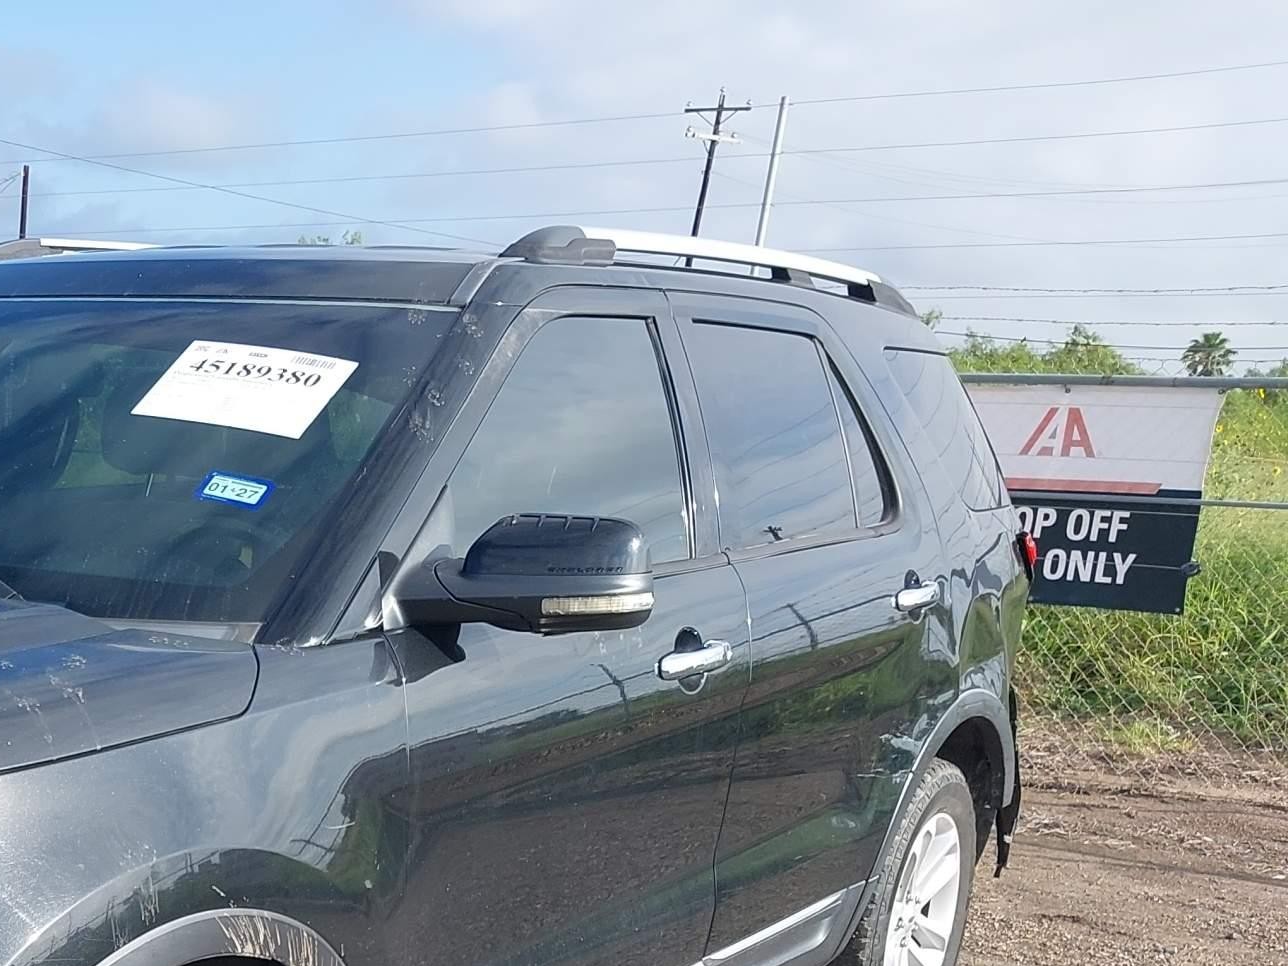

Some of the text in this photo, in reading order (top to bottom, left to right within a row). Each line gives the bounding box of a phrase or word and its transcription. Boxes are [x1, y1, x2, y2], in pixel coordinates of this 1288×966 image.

[188, 358, 322, 388] 45189380
[1066, 507, 1132, 543] OFF
[1042, 548, 1137, 585] ONLY
